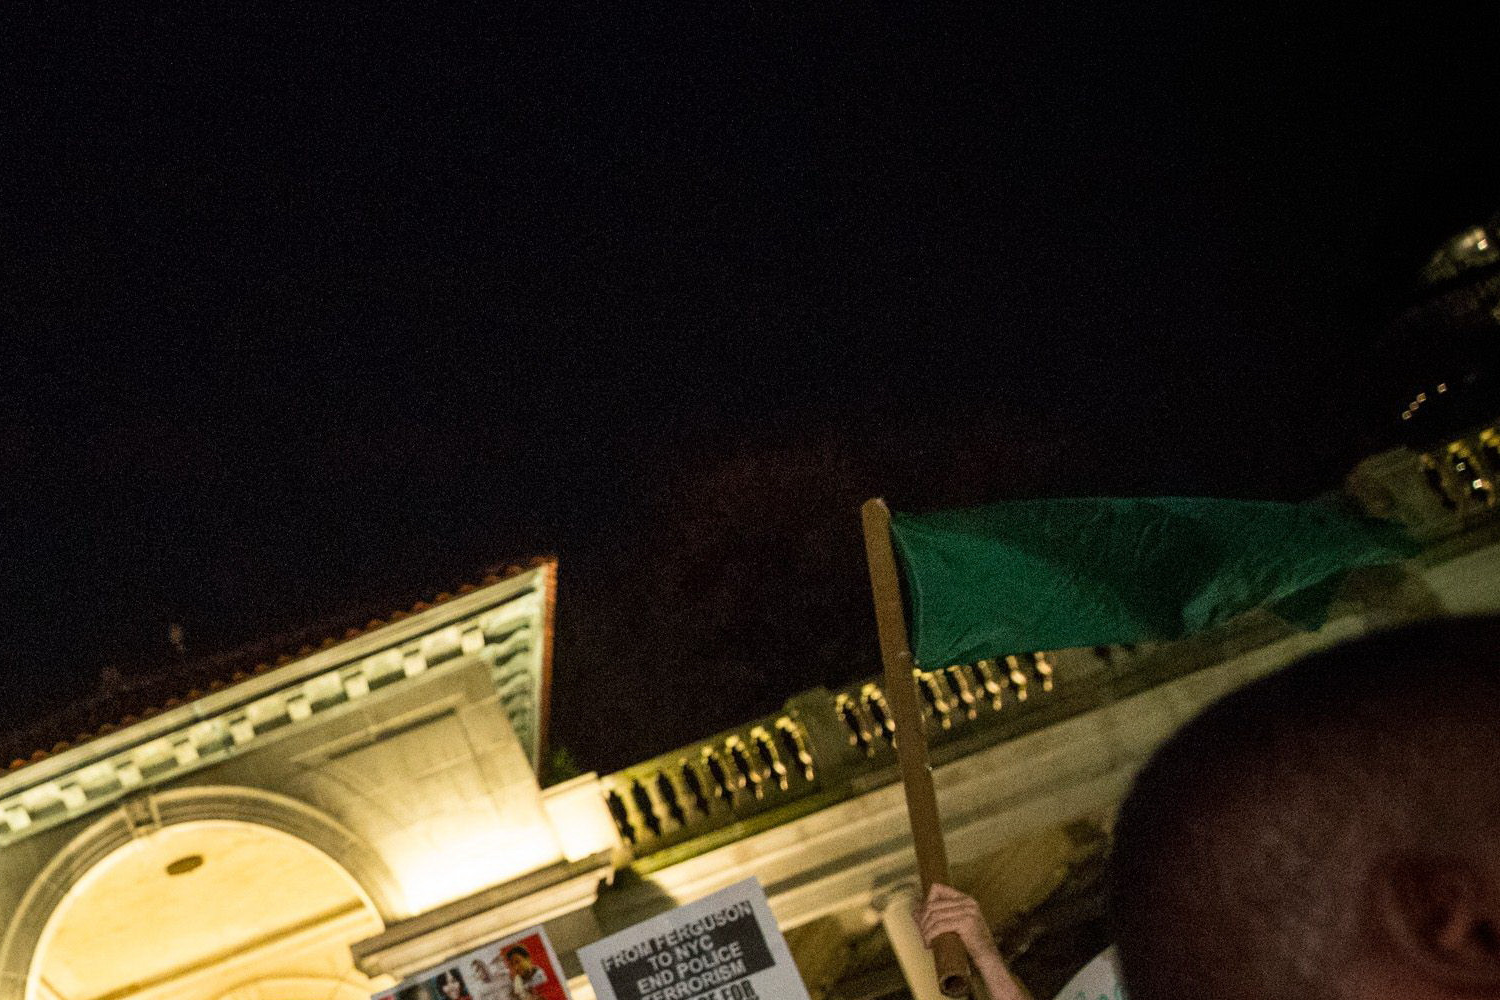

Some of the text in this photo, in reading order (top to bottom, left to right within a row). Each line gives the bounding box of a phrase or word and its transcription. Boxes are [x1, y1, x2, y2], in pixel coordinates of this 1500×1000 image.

[602, 901, 753, 972] FROM FERGUSON
[647, 935, 714, 972] TO NYC
[637, 941, 743, 995] END POLICE
